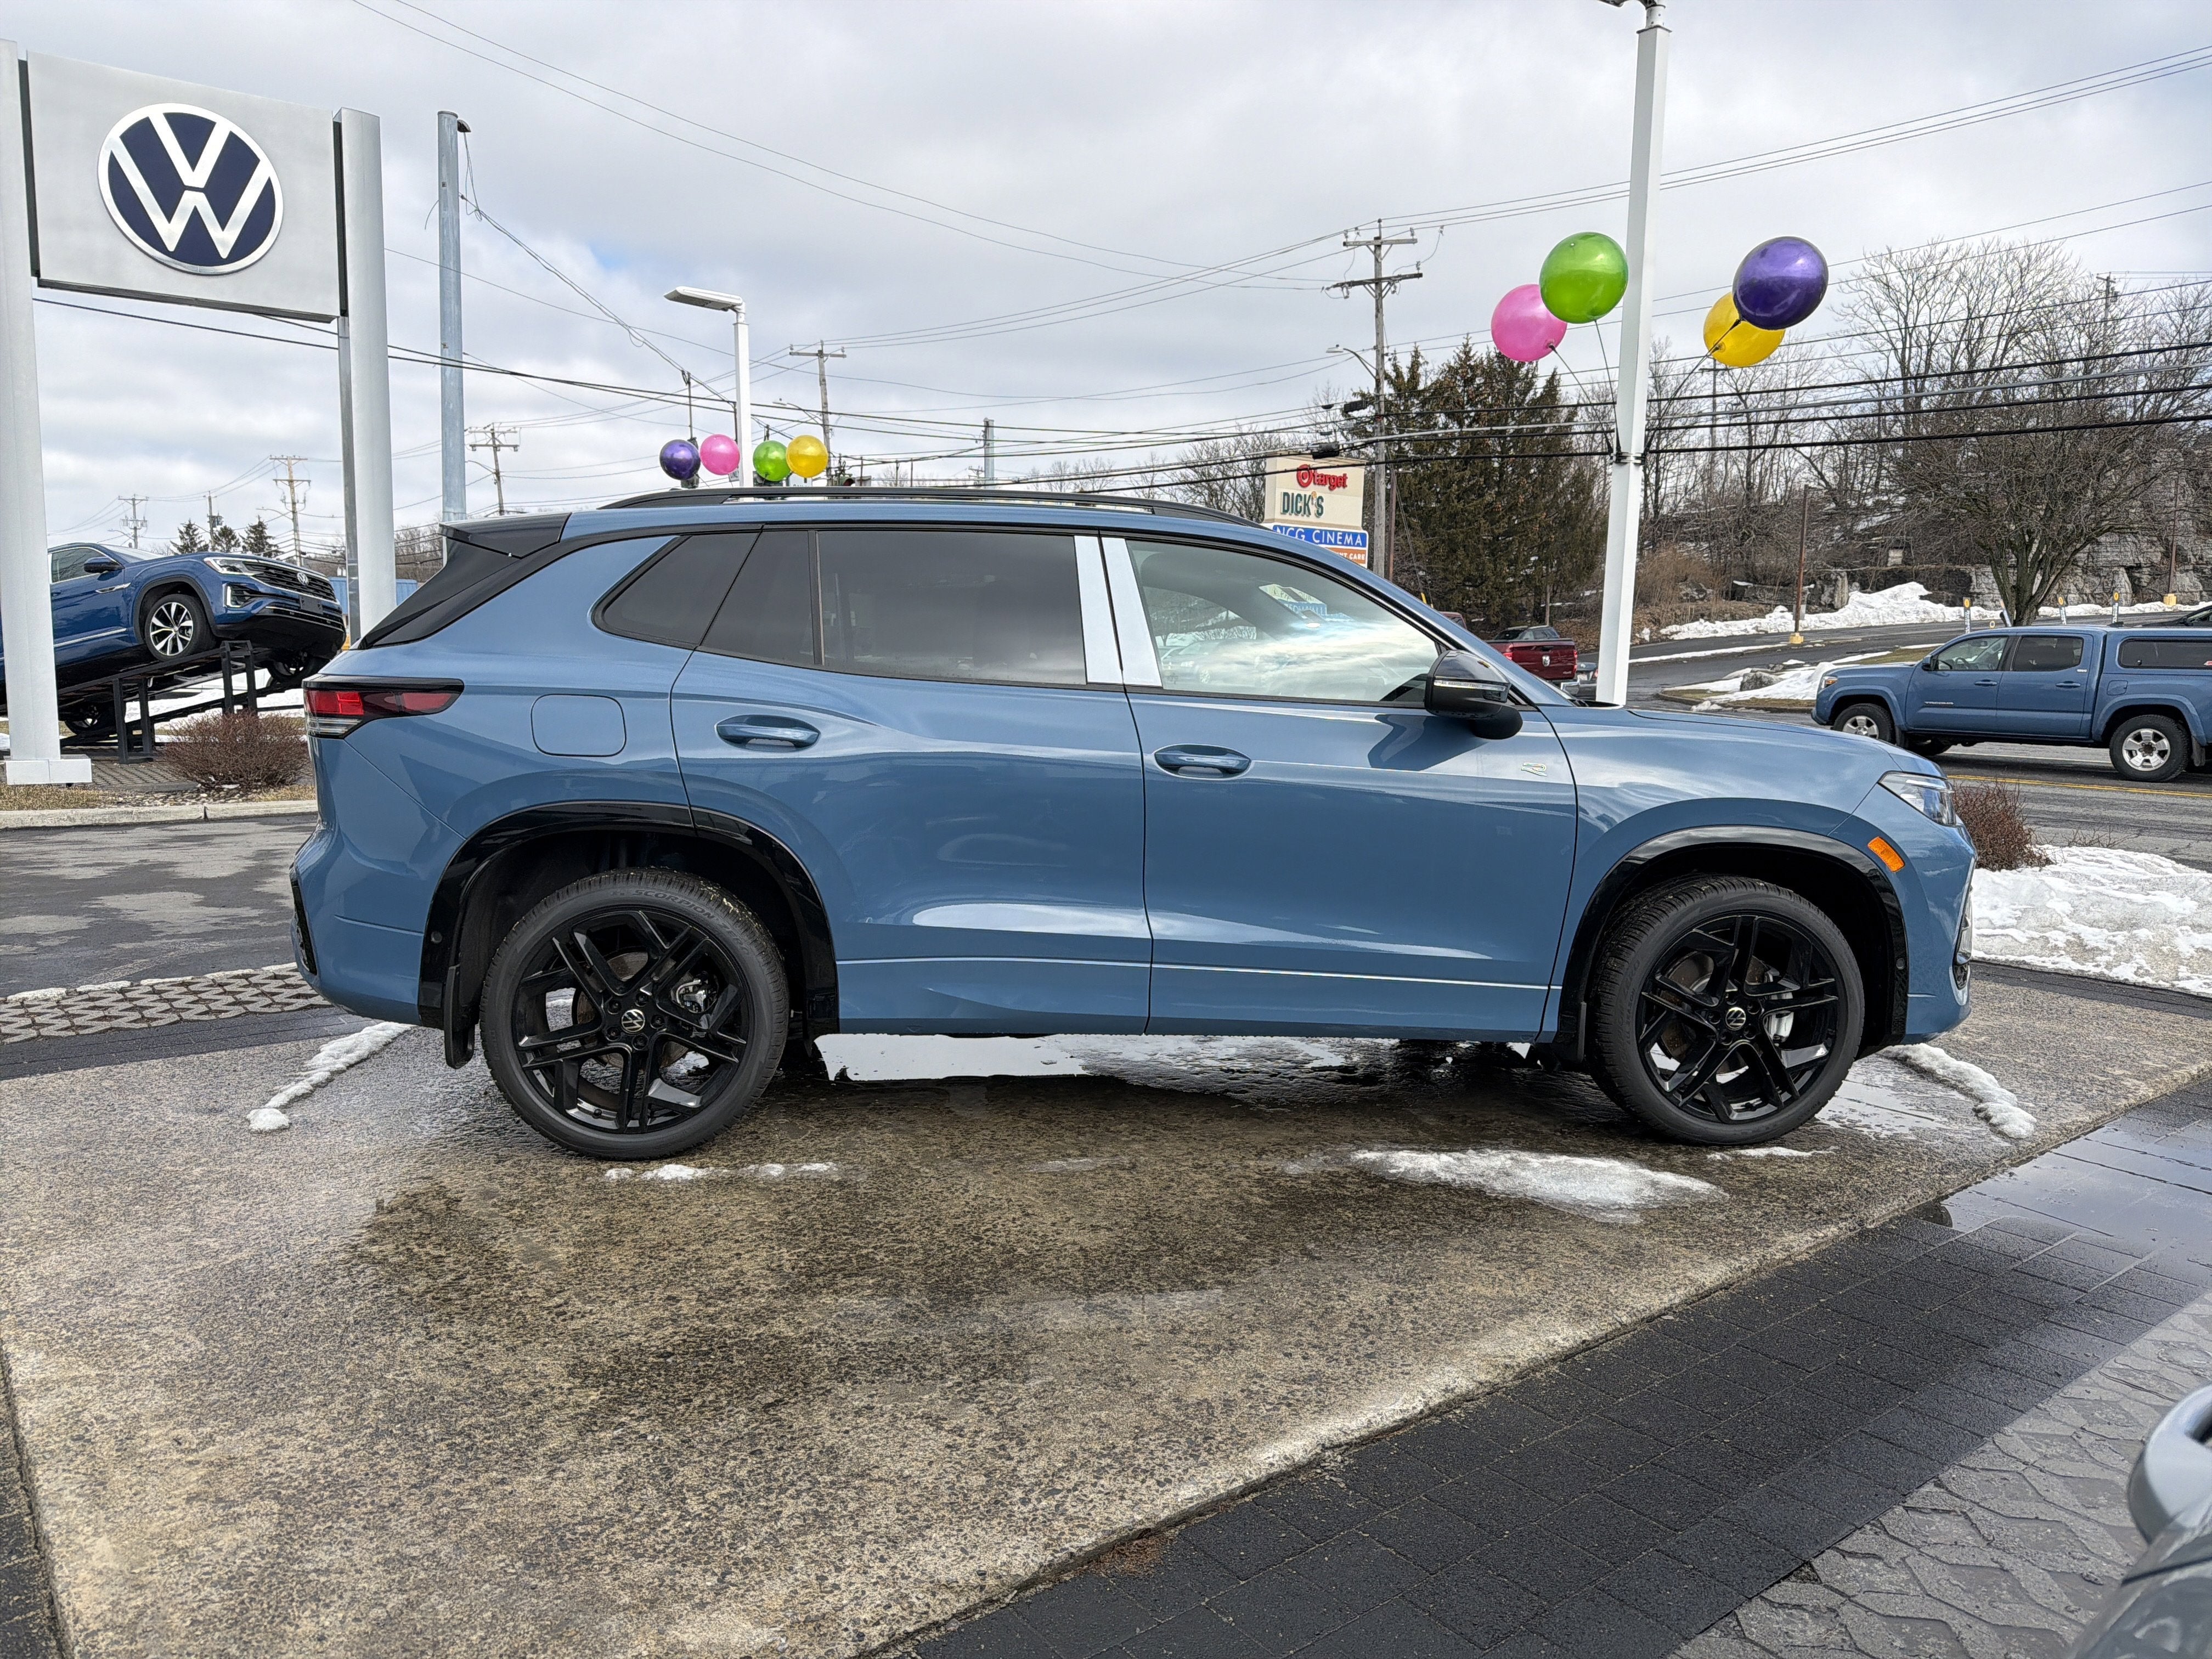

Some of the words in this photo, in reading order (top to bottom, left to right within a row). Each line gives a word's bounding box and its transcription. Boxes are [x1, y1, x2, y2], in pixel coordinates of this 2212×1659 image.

[100, 104, 281, 268] VW
[1313, 470, 1348, 491] target
[1281, 491, 1324, 517] DICK'S
[1312, 530, 1362, 546] CINEMA
[632, 889, 715, 919] SCORPION
